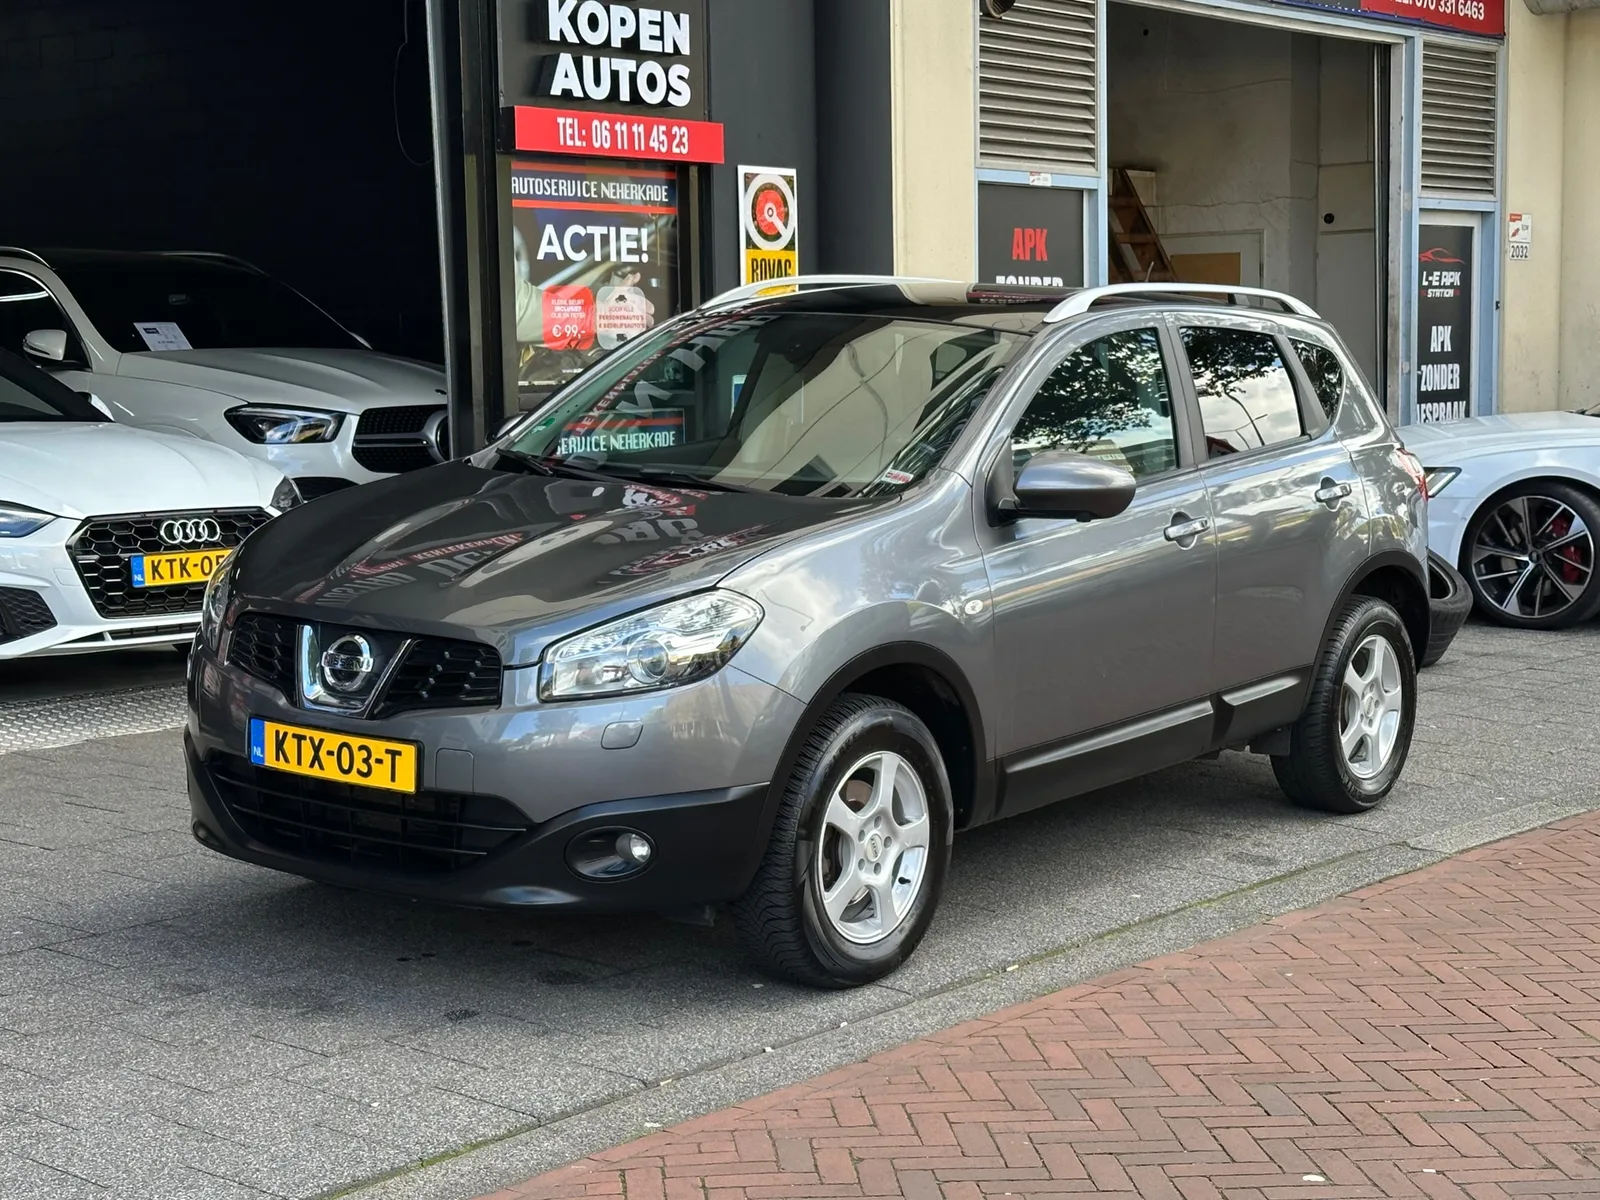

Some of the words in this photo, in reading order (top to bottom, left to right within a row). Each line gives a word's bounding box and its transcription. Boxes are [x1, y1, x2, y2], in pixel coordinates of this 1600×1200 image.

[1458, 0, 1485, 20] 6463
[548, 0, 691, 56] KOPEN
[550, 52, 692, 107] AUTOS
[557, 116, 587, 147] TEL:
[592, 119, 611, 149] 06
[614, 121, 628, 150] 11
[632, 123, 645, 151] 11
[649, 124, 668, 153] 45
[671, 126, 689, 155] 23
[511, 176, 598, 198] AUTOSERVICE
[601, 182, 669, 202] NEHERKADE
[536, 224, 649, 264] ACTIE!
[1012, 227, 1048, 262] APK
[1511, 245, 1529, 259] 2032
[1422, 271, 1440, 286] L-E
[1441, 271, 1461, 286] APK
[1427, 288, 1454, 298] STATION
[1430, 325, 1452, 353] APK
[1420, 363, 1460, 391] ZONDER
[610, 431, 676, 451] NEHERKADE
[253, 746, 263, 757] NL
[275, 729, 402, 783] KTX-03-T
